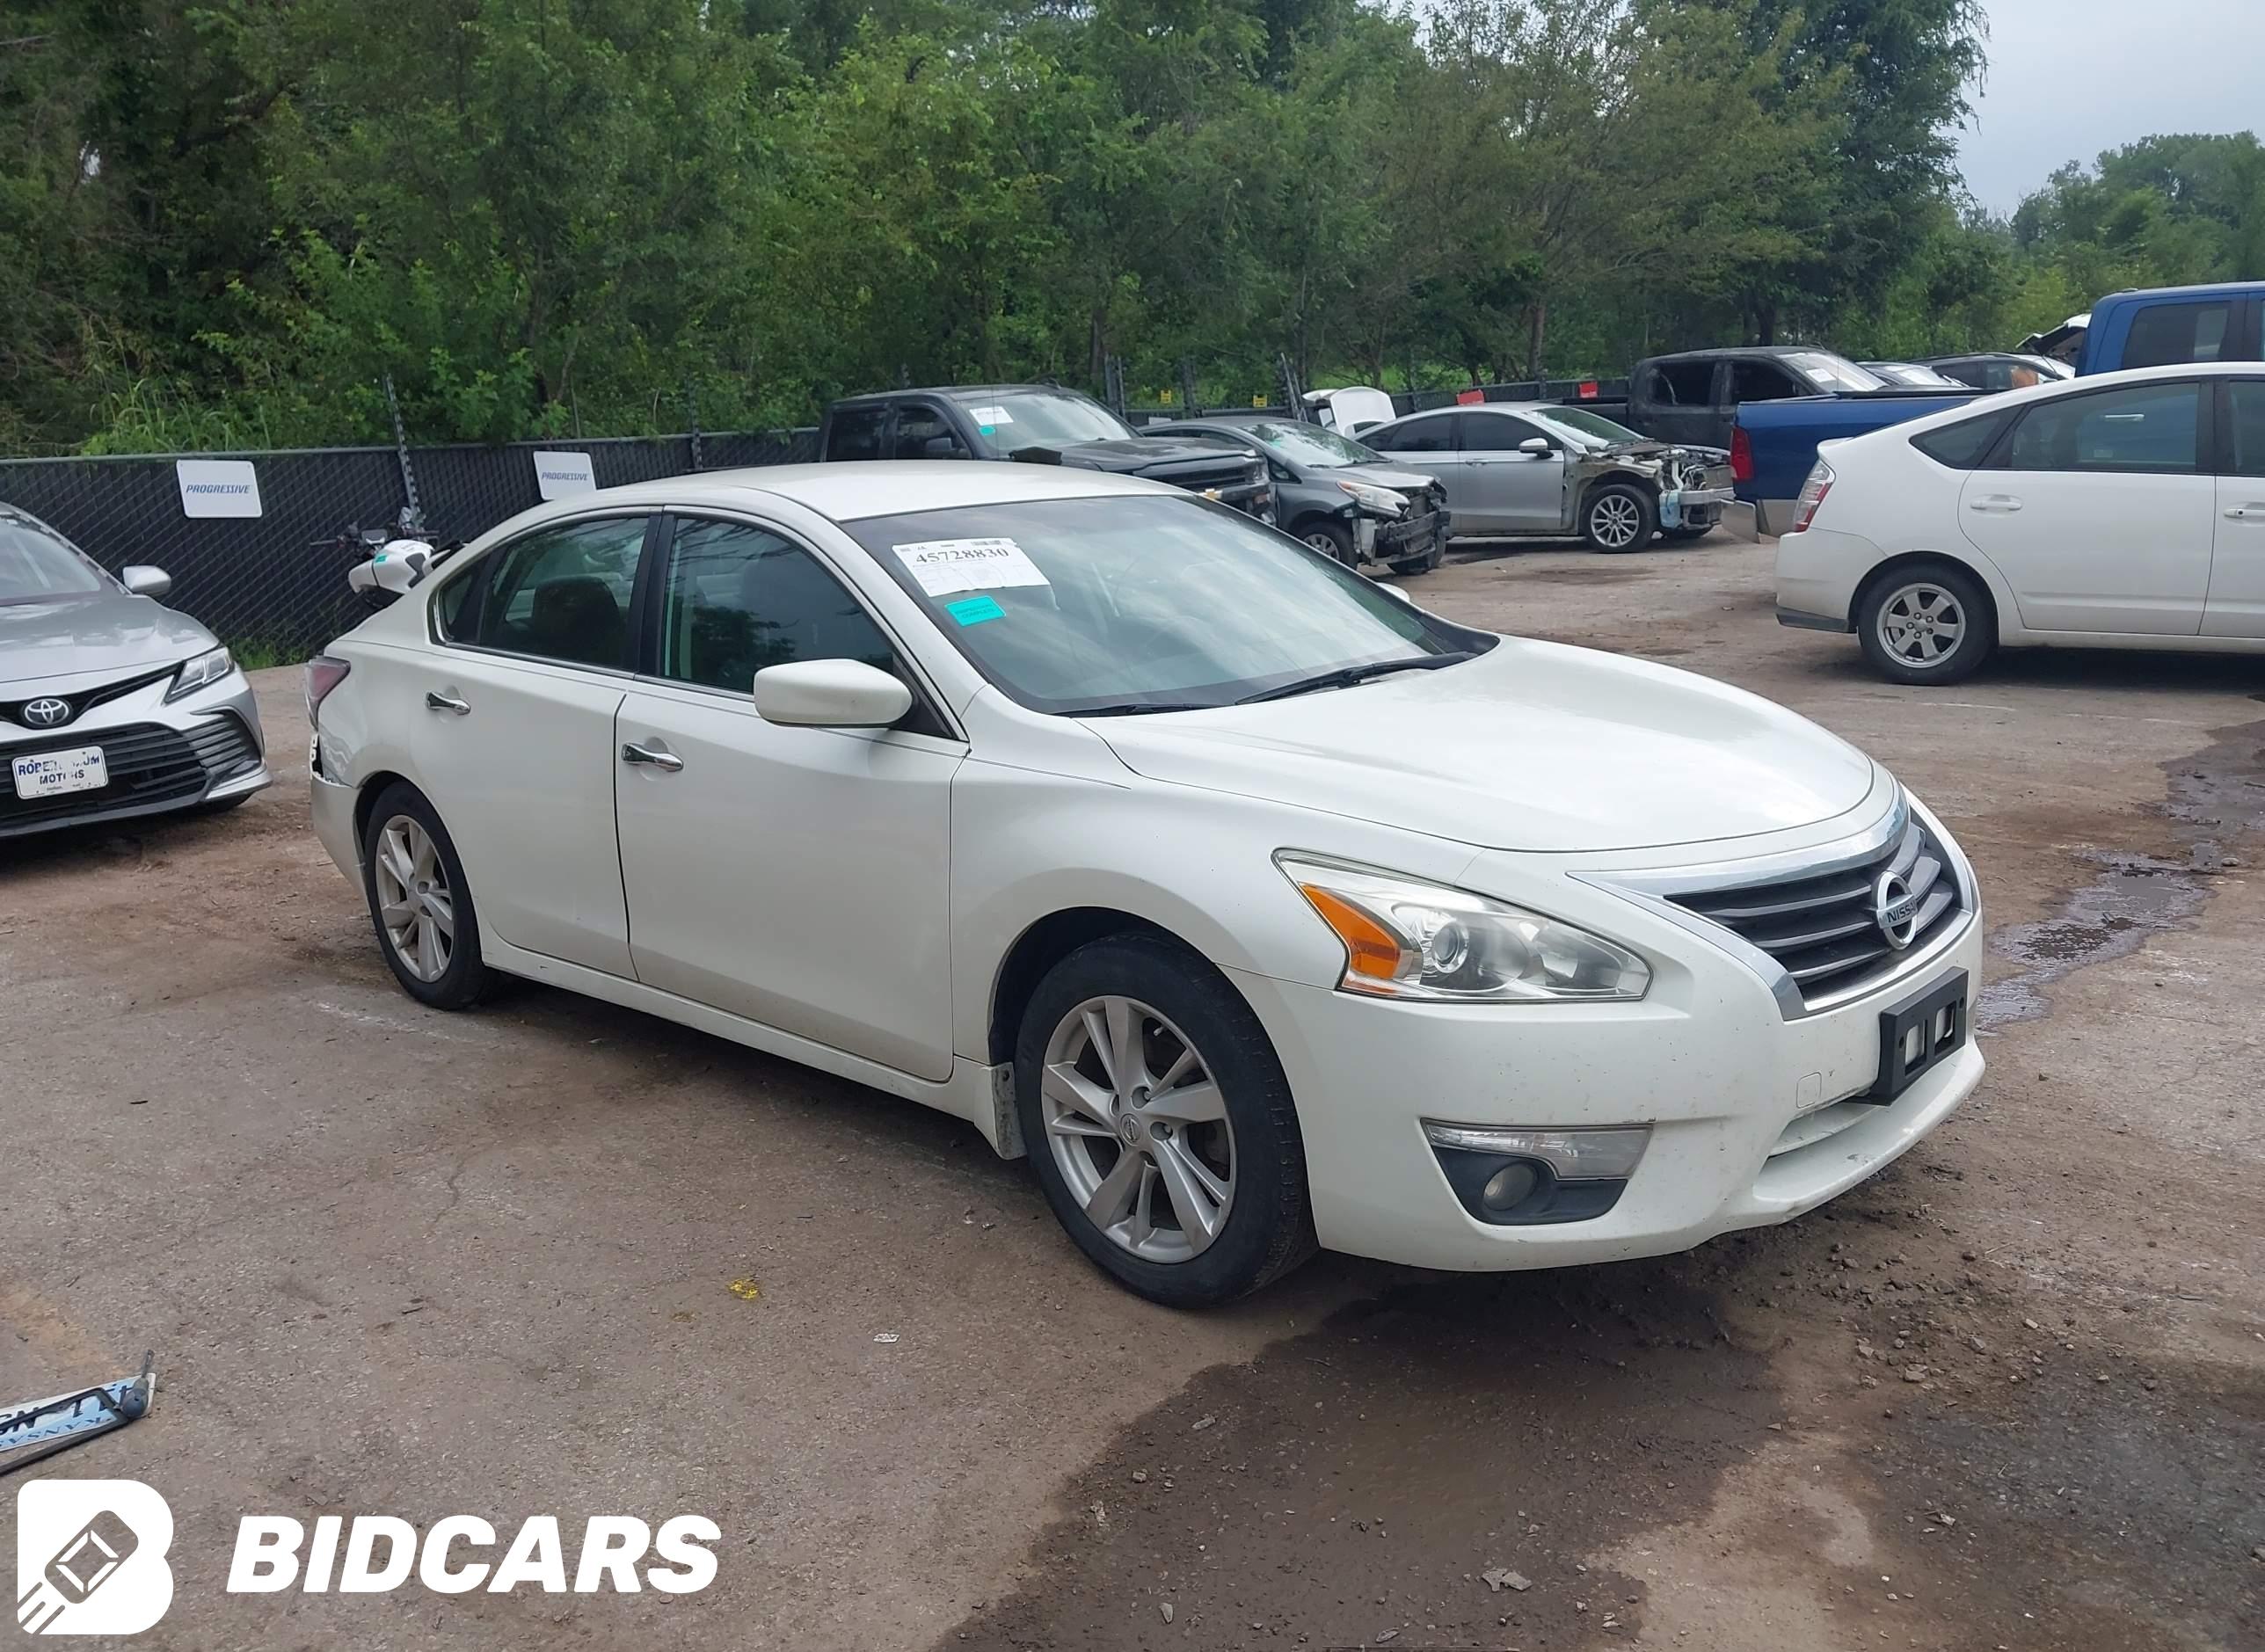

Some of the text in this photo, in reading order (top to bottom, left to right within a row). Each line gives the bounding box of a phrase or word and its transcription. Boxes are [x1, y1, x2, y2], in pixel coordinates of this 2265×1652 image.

[543, 472, 587, 481] PROGRESSIVE
[186, 484, 250, 494] PROGRESSIVE
[916, 549, 1009, 563] 45728830
[1887, 901, 1916, 923] NISSA
